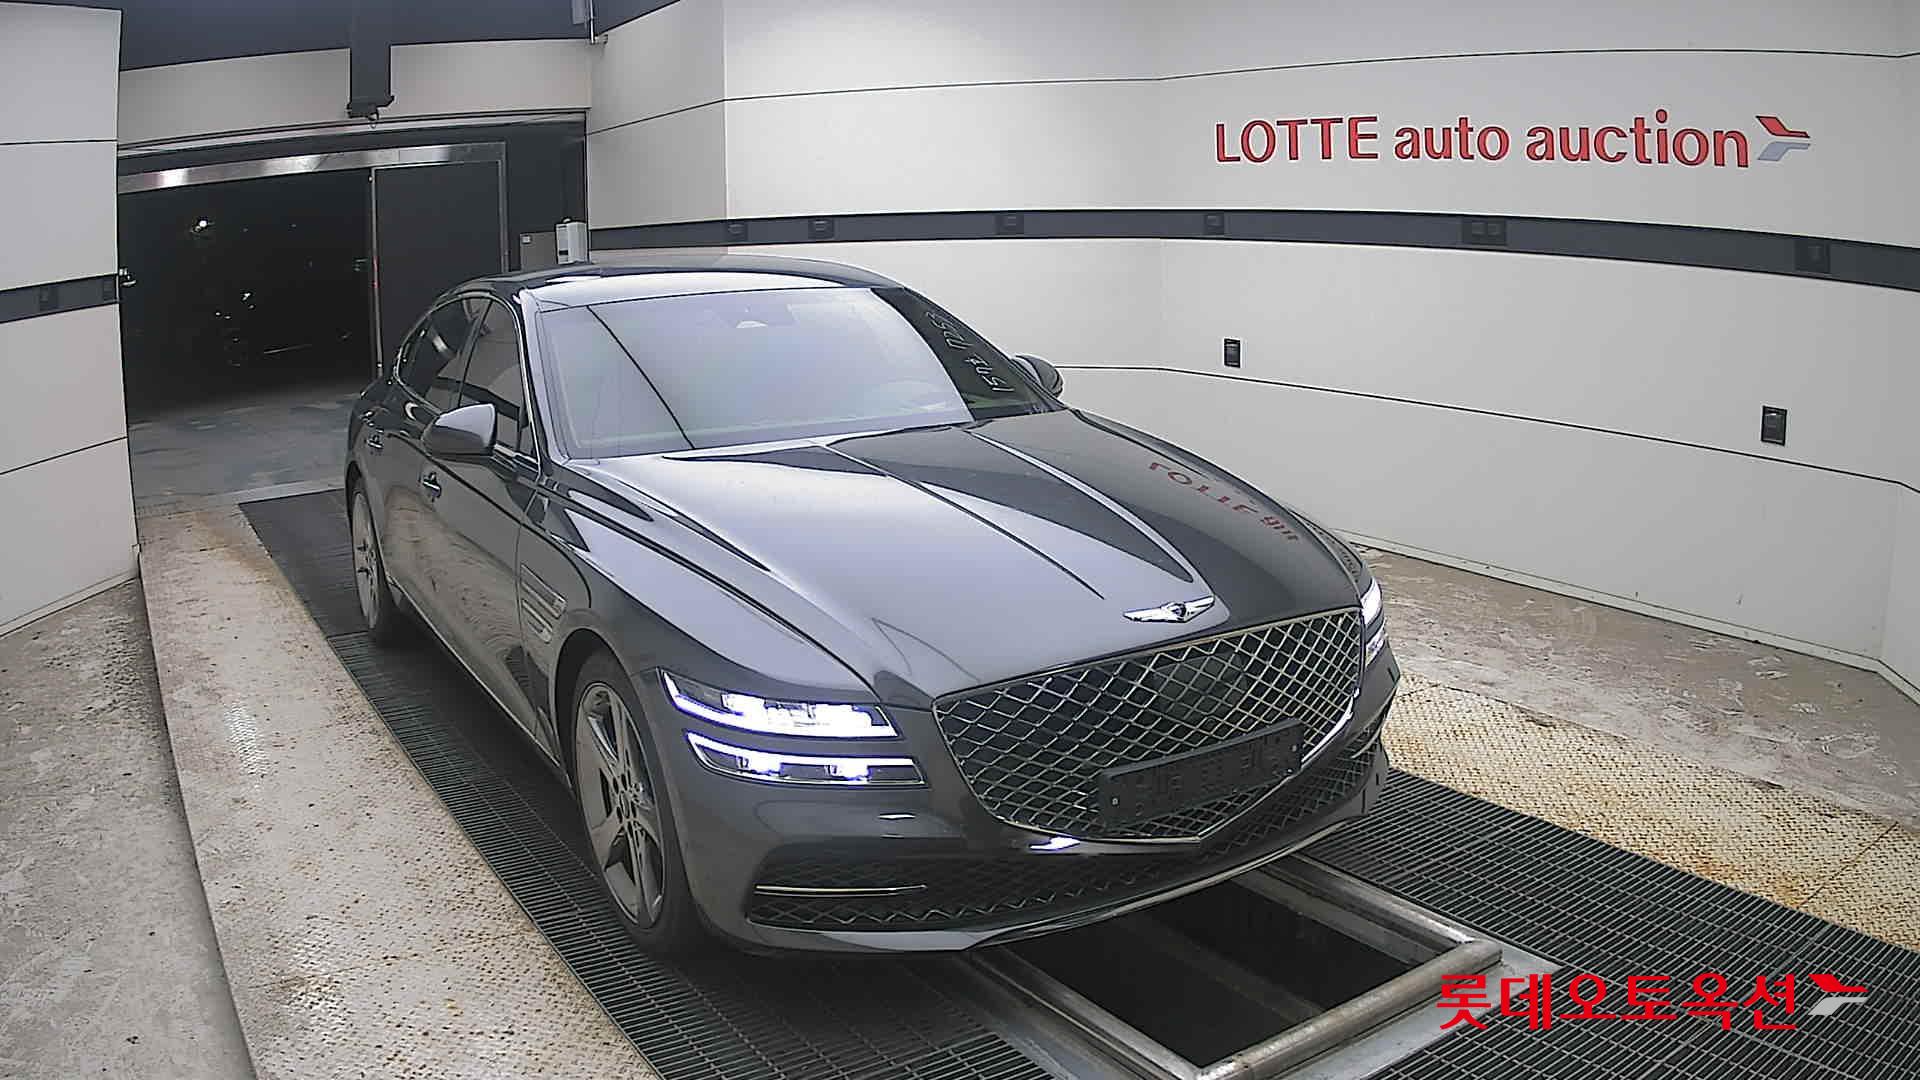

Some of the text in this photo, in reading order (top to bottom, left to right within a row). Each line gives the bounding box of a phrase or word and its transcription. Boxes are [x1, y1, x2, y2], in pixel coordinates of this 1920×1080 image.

[1216, 109, 1750, 168] LOTTE auto auction
